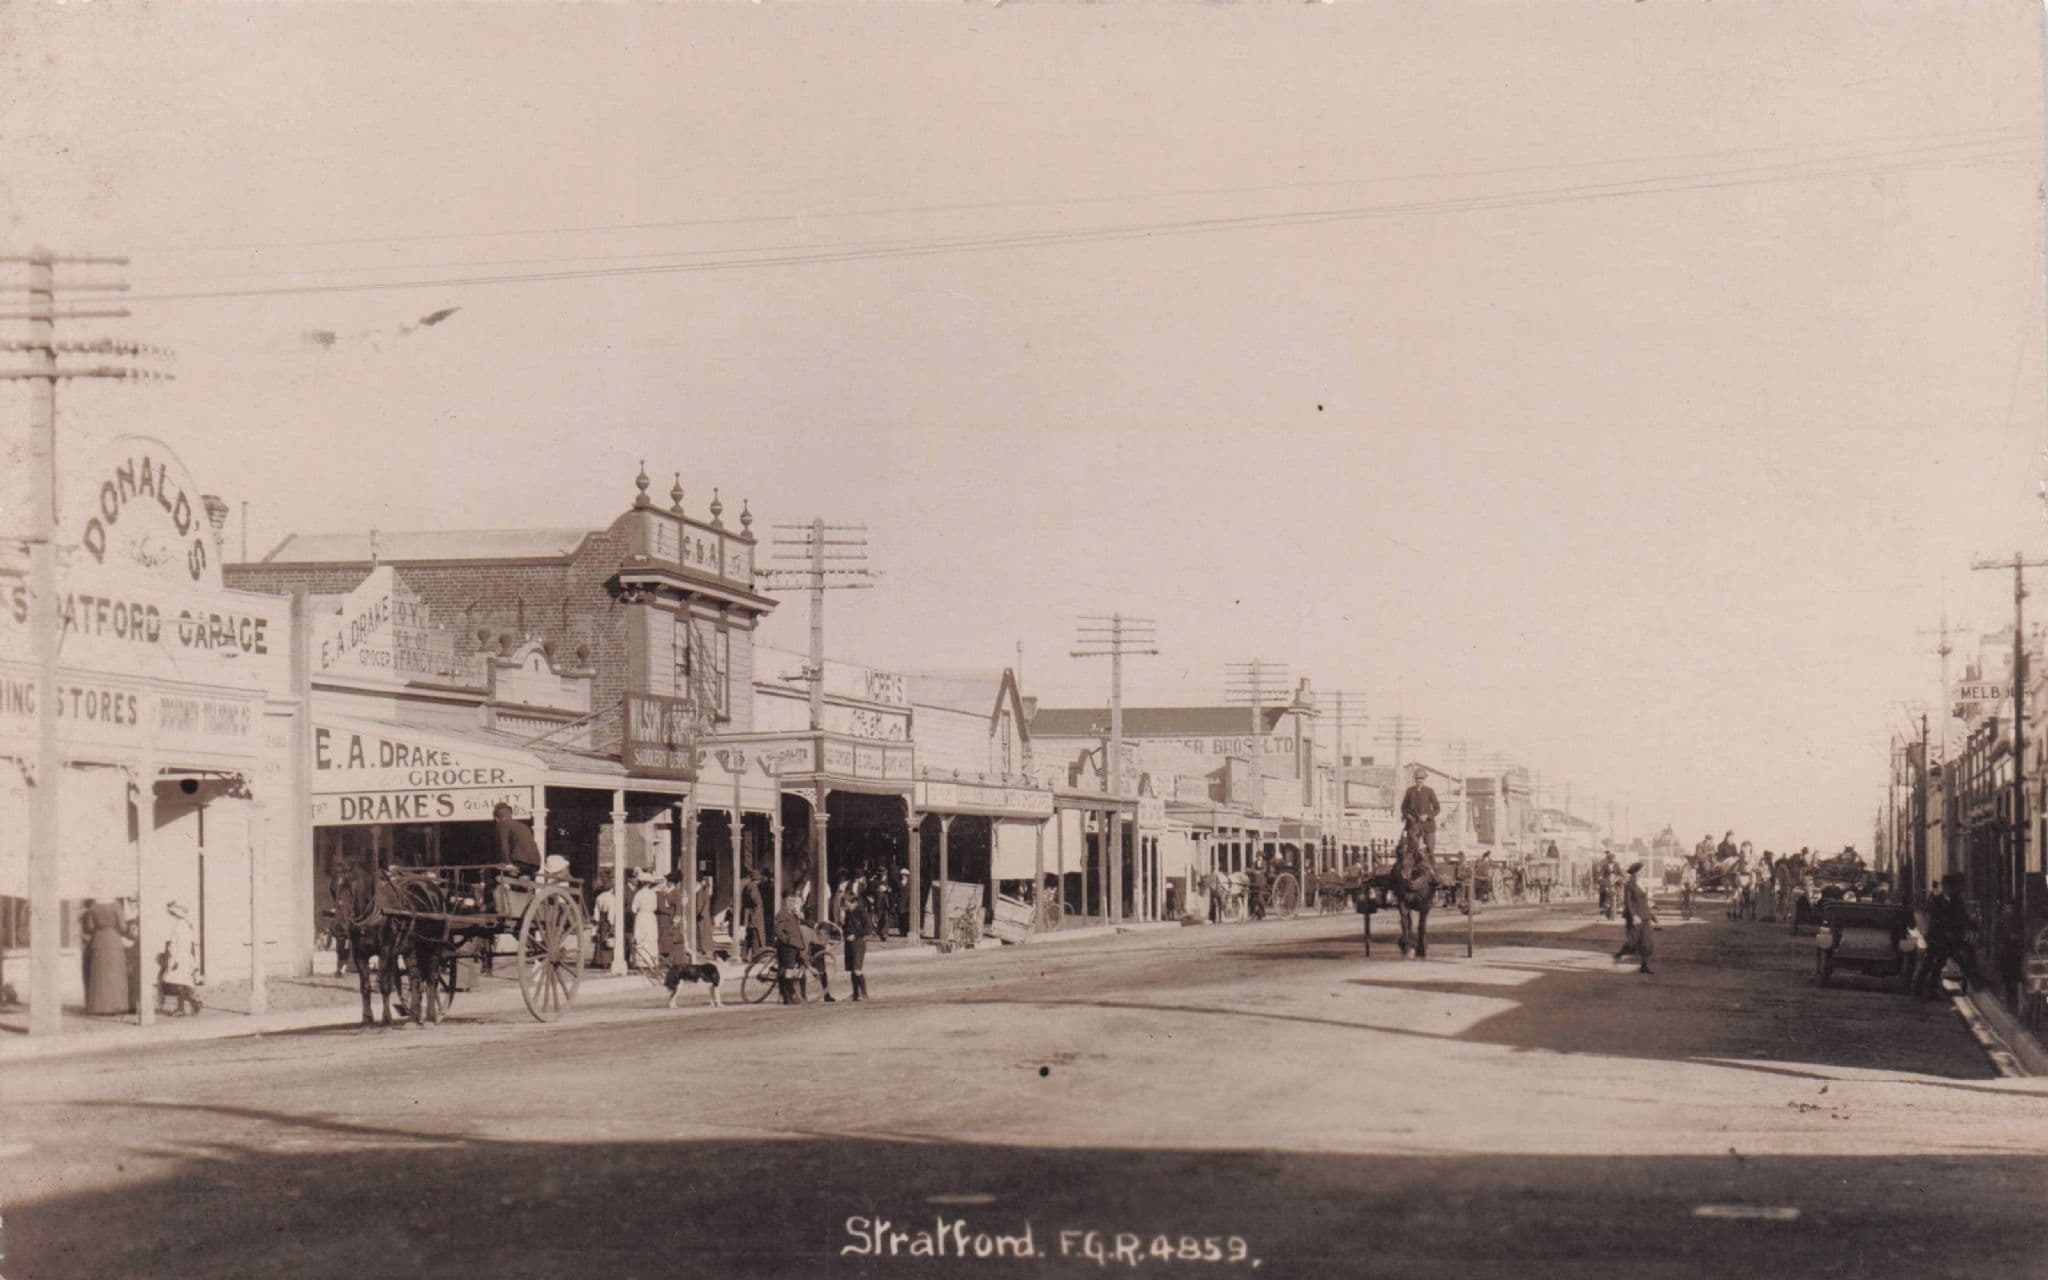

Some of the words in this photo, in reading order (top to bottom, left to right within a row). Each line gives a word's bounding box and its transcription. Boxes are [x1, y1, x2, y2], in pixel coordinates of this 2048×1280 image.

[84, 455, 207, 582] DONALD'S
[178, 610, 268, 655] GARAGE
[54, 685, 138, 726] STORES
[1263, 736, 1295, 754] LTD
[339, 793, 456, 822] DRAKE'S
[463, 793, 521, 810] QUALTY
